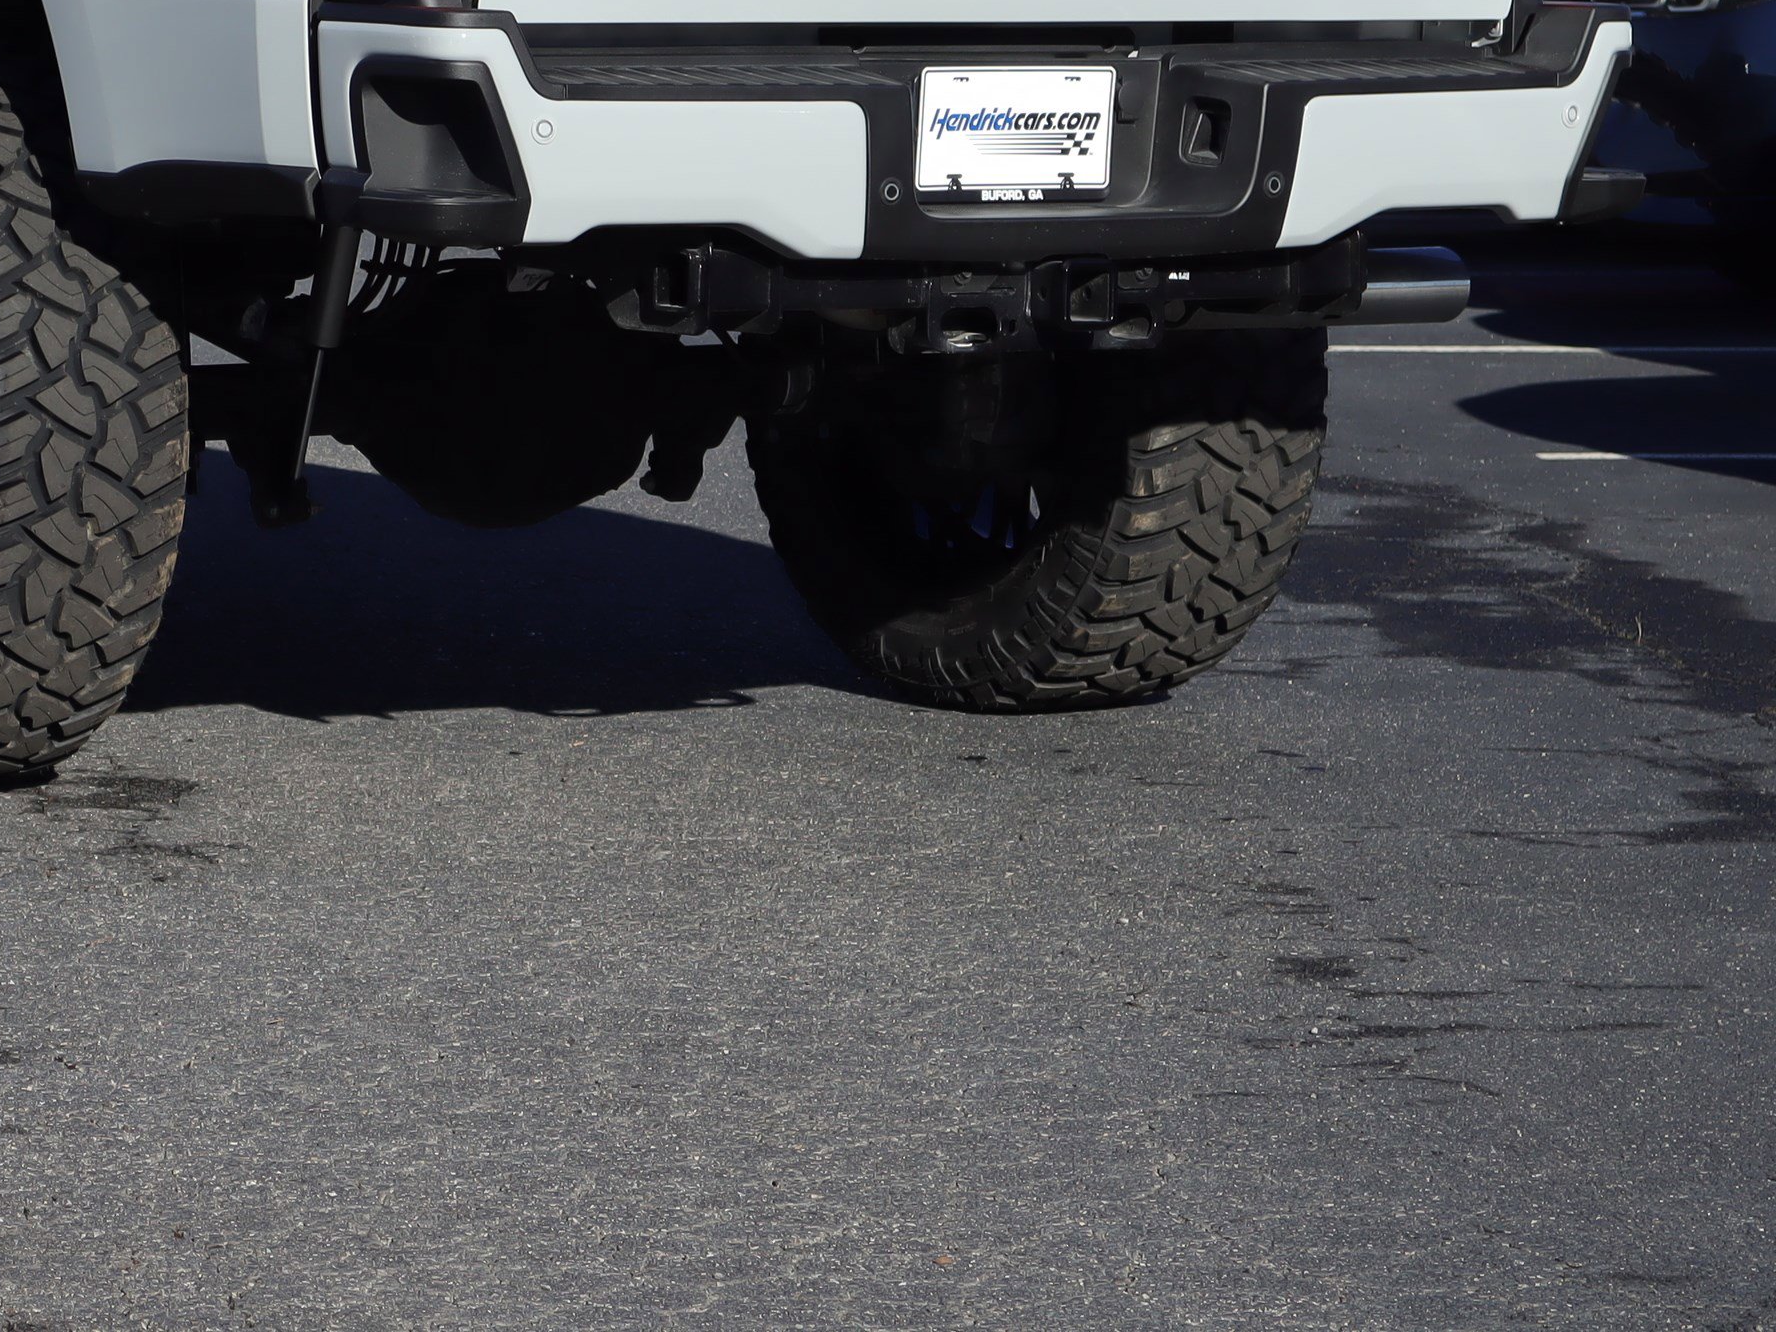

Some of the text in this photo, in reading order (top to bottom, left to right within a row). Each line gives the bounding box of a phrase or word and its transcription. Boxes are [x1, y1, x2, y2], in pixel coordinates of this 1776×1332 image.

[929, 107, 1101, 140] Hendrickcars.com
[981, 189, 1044, 201] BUFORD, GA
